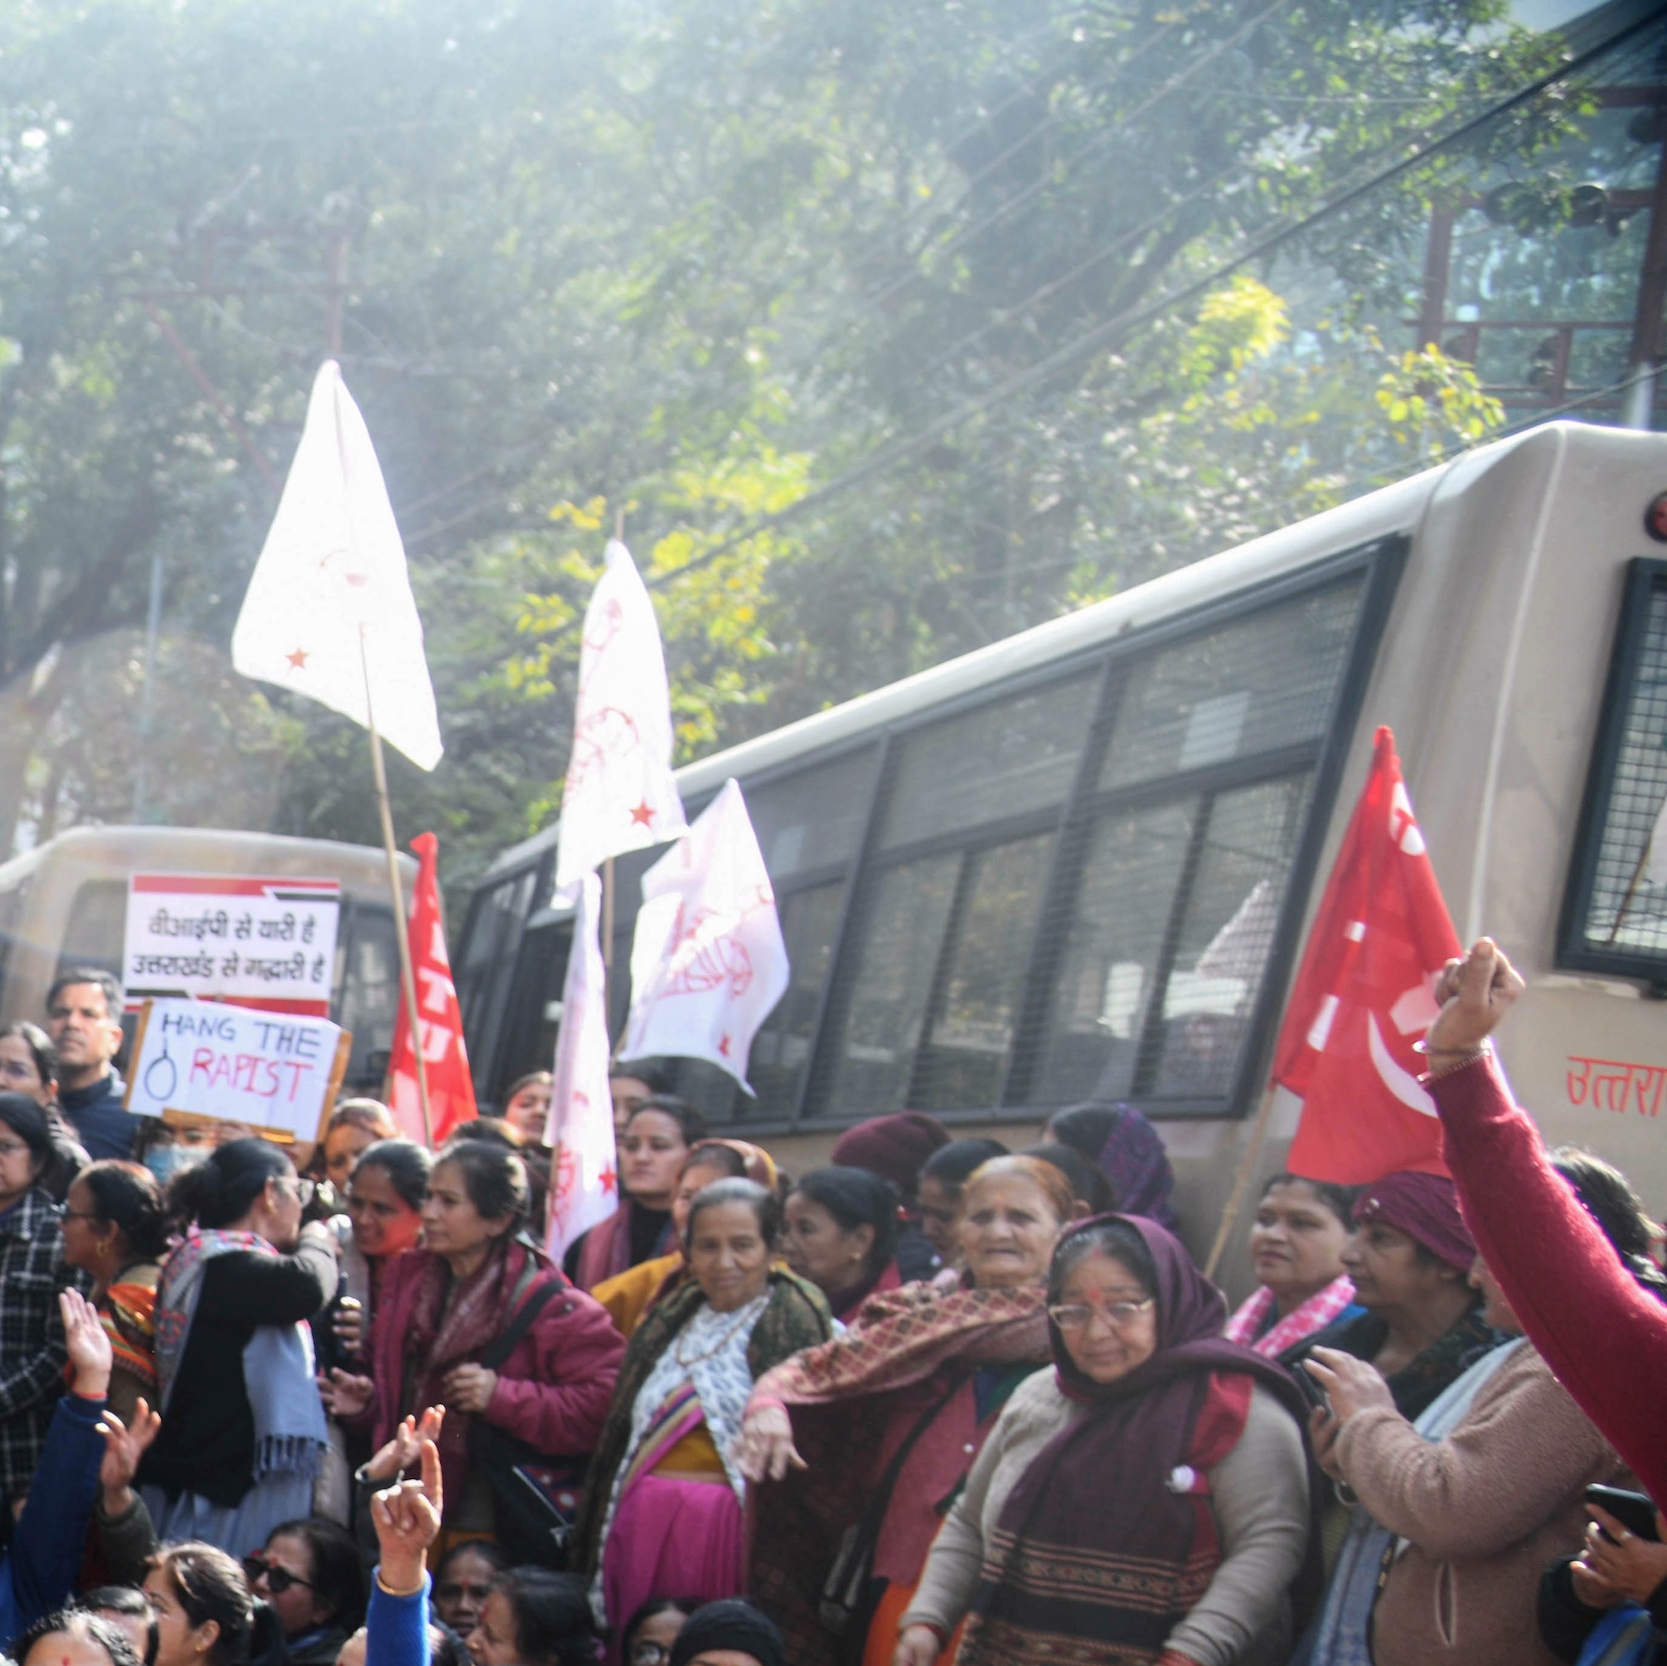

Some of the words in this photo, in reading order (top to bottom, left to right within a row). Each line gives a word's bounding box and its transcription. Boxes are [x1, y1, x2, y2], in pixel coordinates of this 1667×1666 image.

[149, 908, 228, 939] वीआईपी
[234, 912, 252, 940] से
[258, 912, 295, 941] यारी
[220, 951, 239, 978] से
[161, 1013, 236, 1041] HANG
[253, 1020, 321, 1059] THE
[188, 1048, 315, 1102] RAPIST
[1567, 1055, 1667, 1117] उत्तरा
